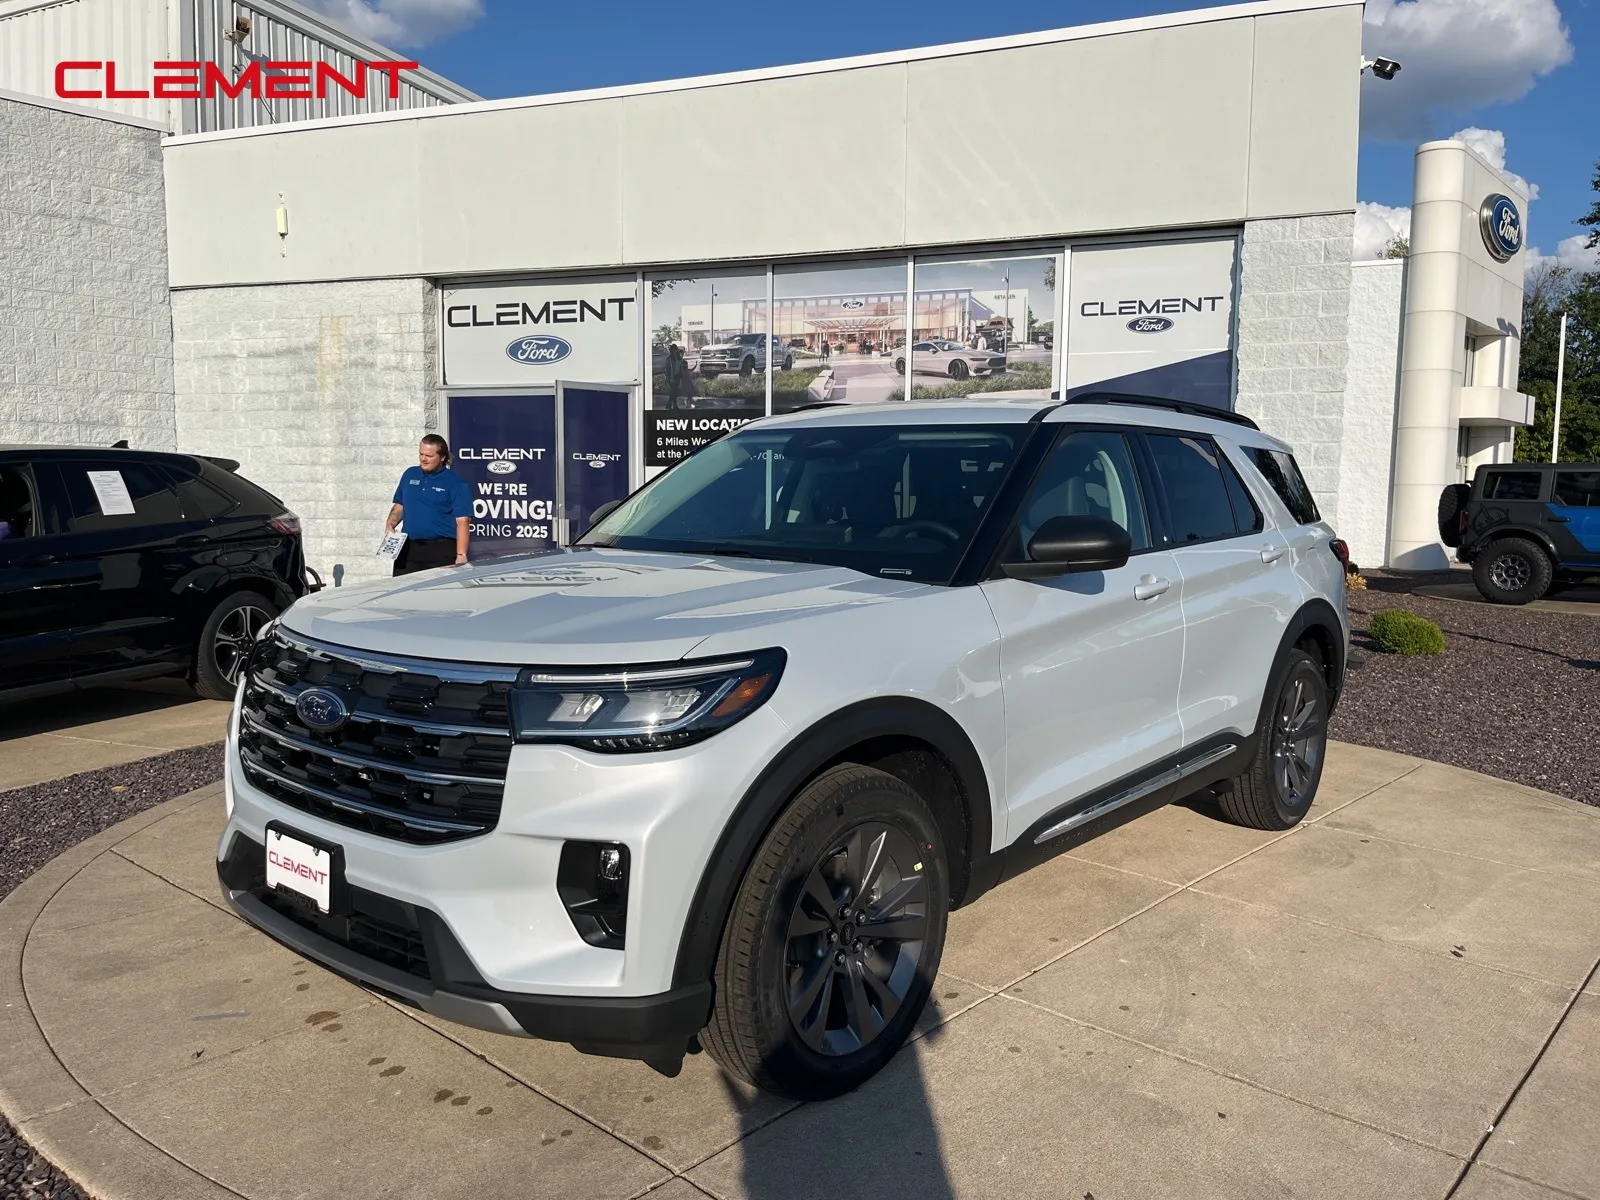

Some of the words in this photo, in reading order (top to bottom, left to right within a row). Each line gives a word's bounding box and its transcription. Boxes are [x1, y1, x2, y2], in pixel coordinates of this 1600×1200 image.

[1499, 206, 1520, 245] Ford
[447, 297, 635, 328] CLEMENT
[1080, 296, 1224, 317] CLEMENT
[516, 338, 561, 361] Ford
[656, 419, 689, 431] NEW
[656, 437, 663, 446] 6
[665, 437, 689, 446] Miles
[458, 448, 546, 460] CLEMENT
[572, 452, 621, 461] CLEMENT
[656, 450, 666, 459] at
[667, 449, 682, 459] the
[473, 498, 553, 520] OVING!
[468, 524, 512, 537] PRING
[516, 525, 548, 539] 2025
[268, 850, 327, 885] CLEMENT
